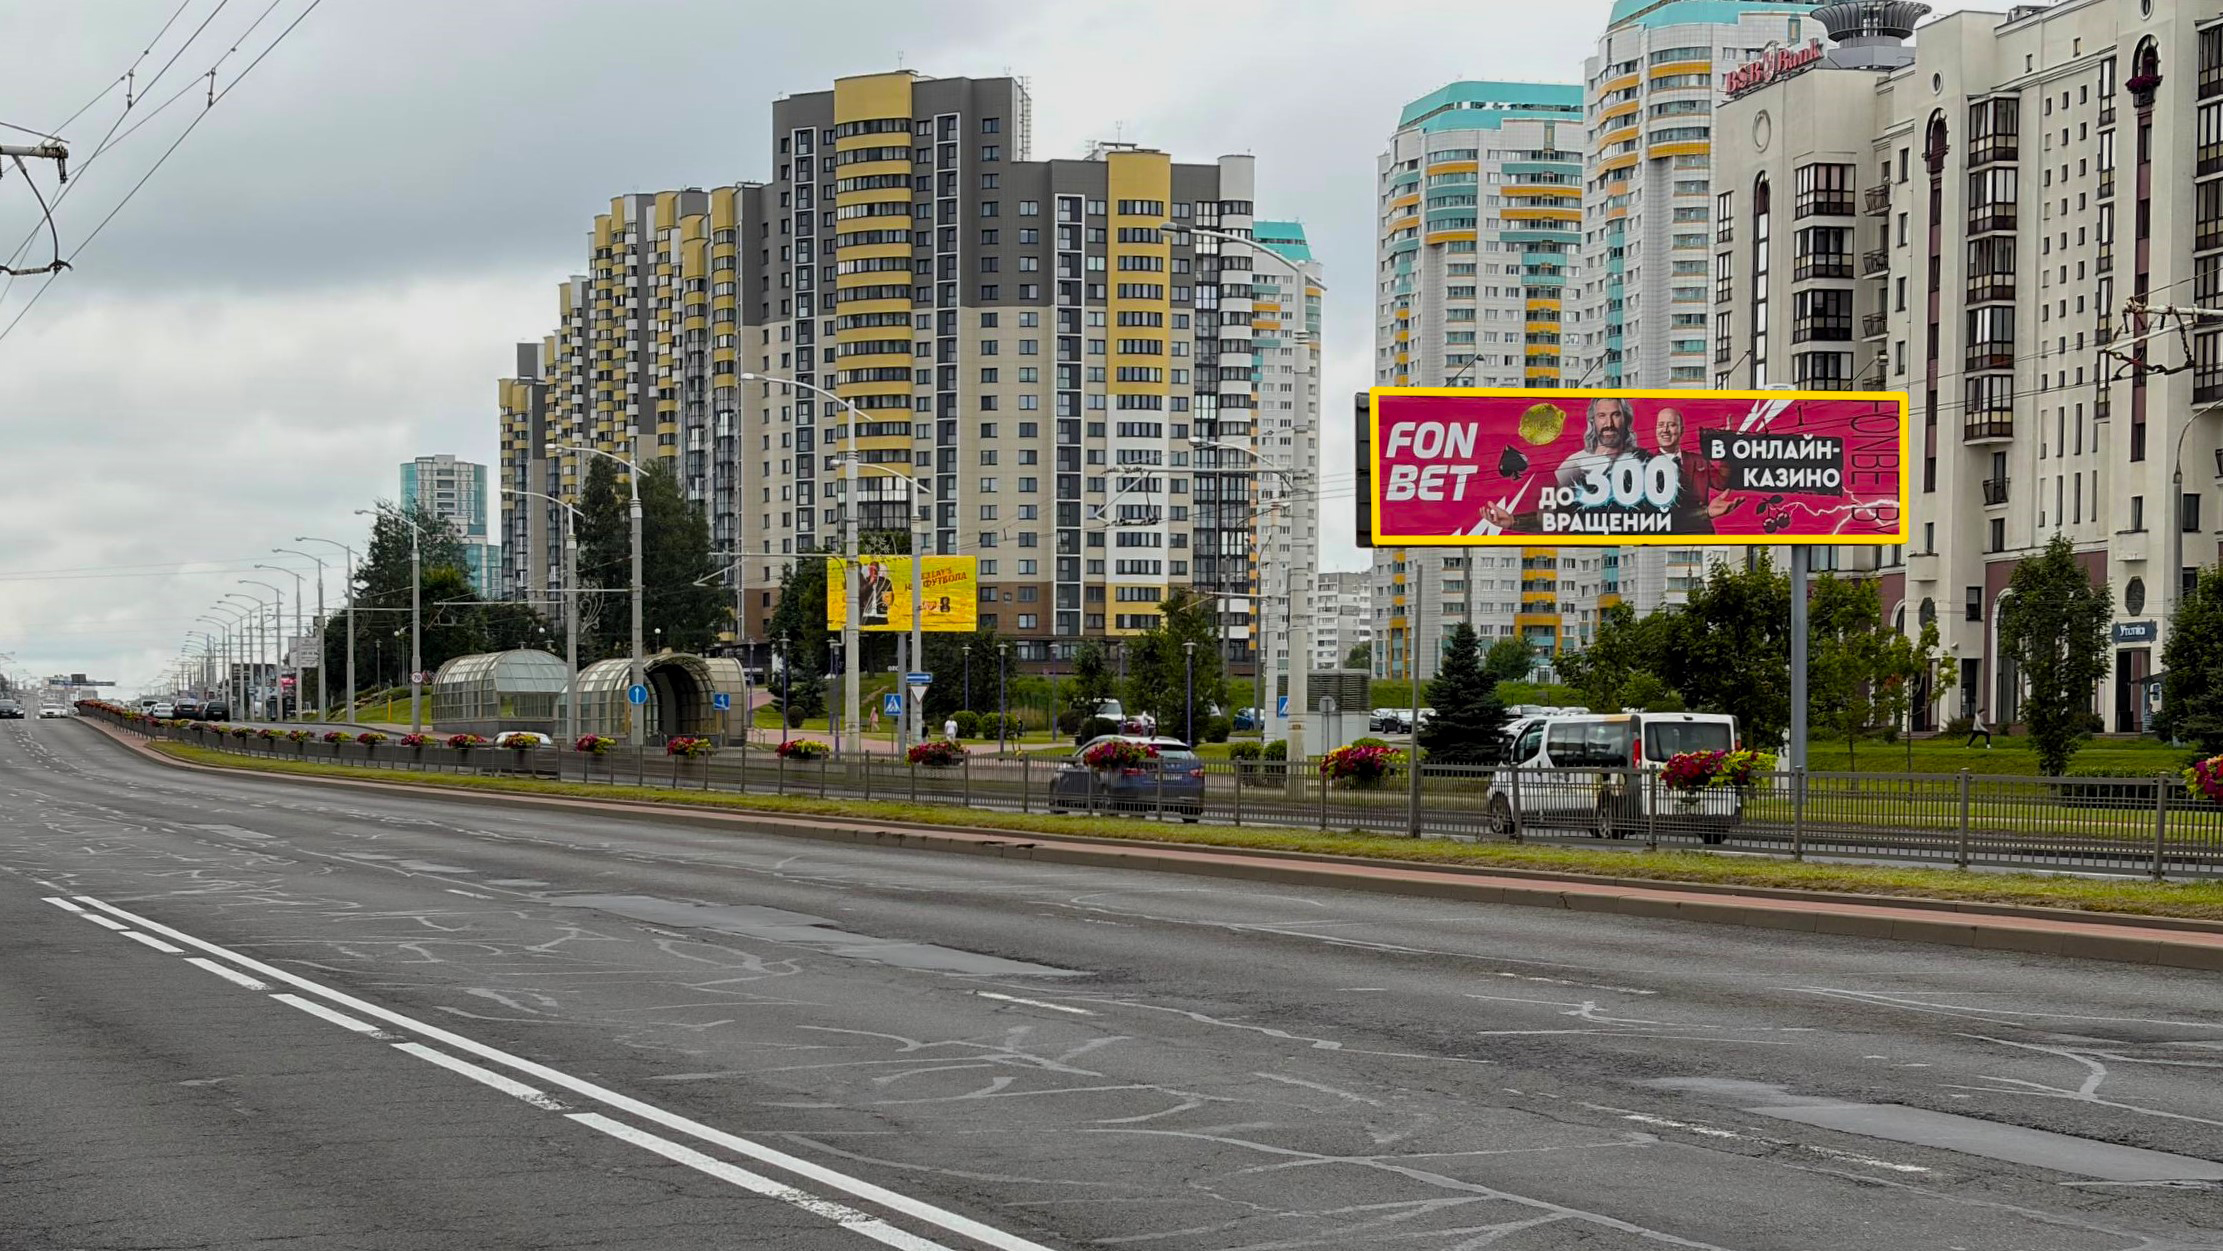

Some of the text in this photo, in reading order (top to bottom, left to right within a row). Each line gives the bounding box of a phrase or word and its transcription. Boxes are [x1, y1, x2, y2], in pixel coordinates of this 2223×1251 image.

[1778, 38, 1824, 71] Bank
[1385, 421, 1479, 459] FON
[1711, 434, 1840, 460] В ОНЛАЙН-
[1385, 464, 1479, 501] BET
[1539, 452, 1678, 510] ДО 300
[1743, 467, 1840, 488] КАЗИНО
[1542, 507, 1672, 535] ВРАЩЕНИЙ
[923, 571, 967, 587] ФУТБОЛА
